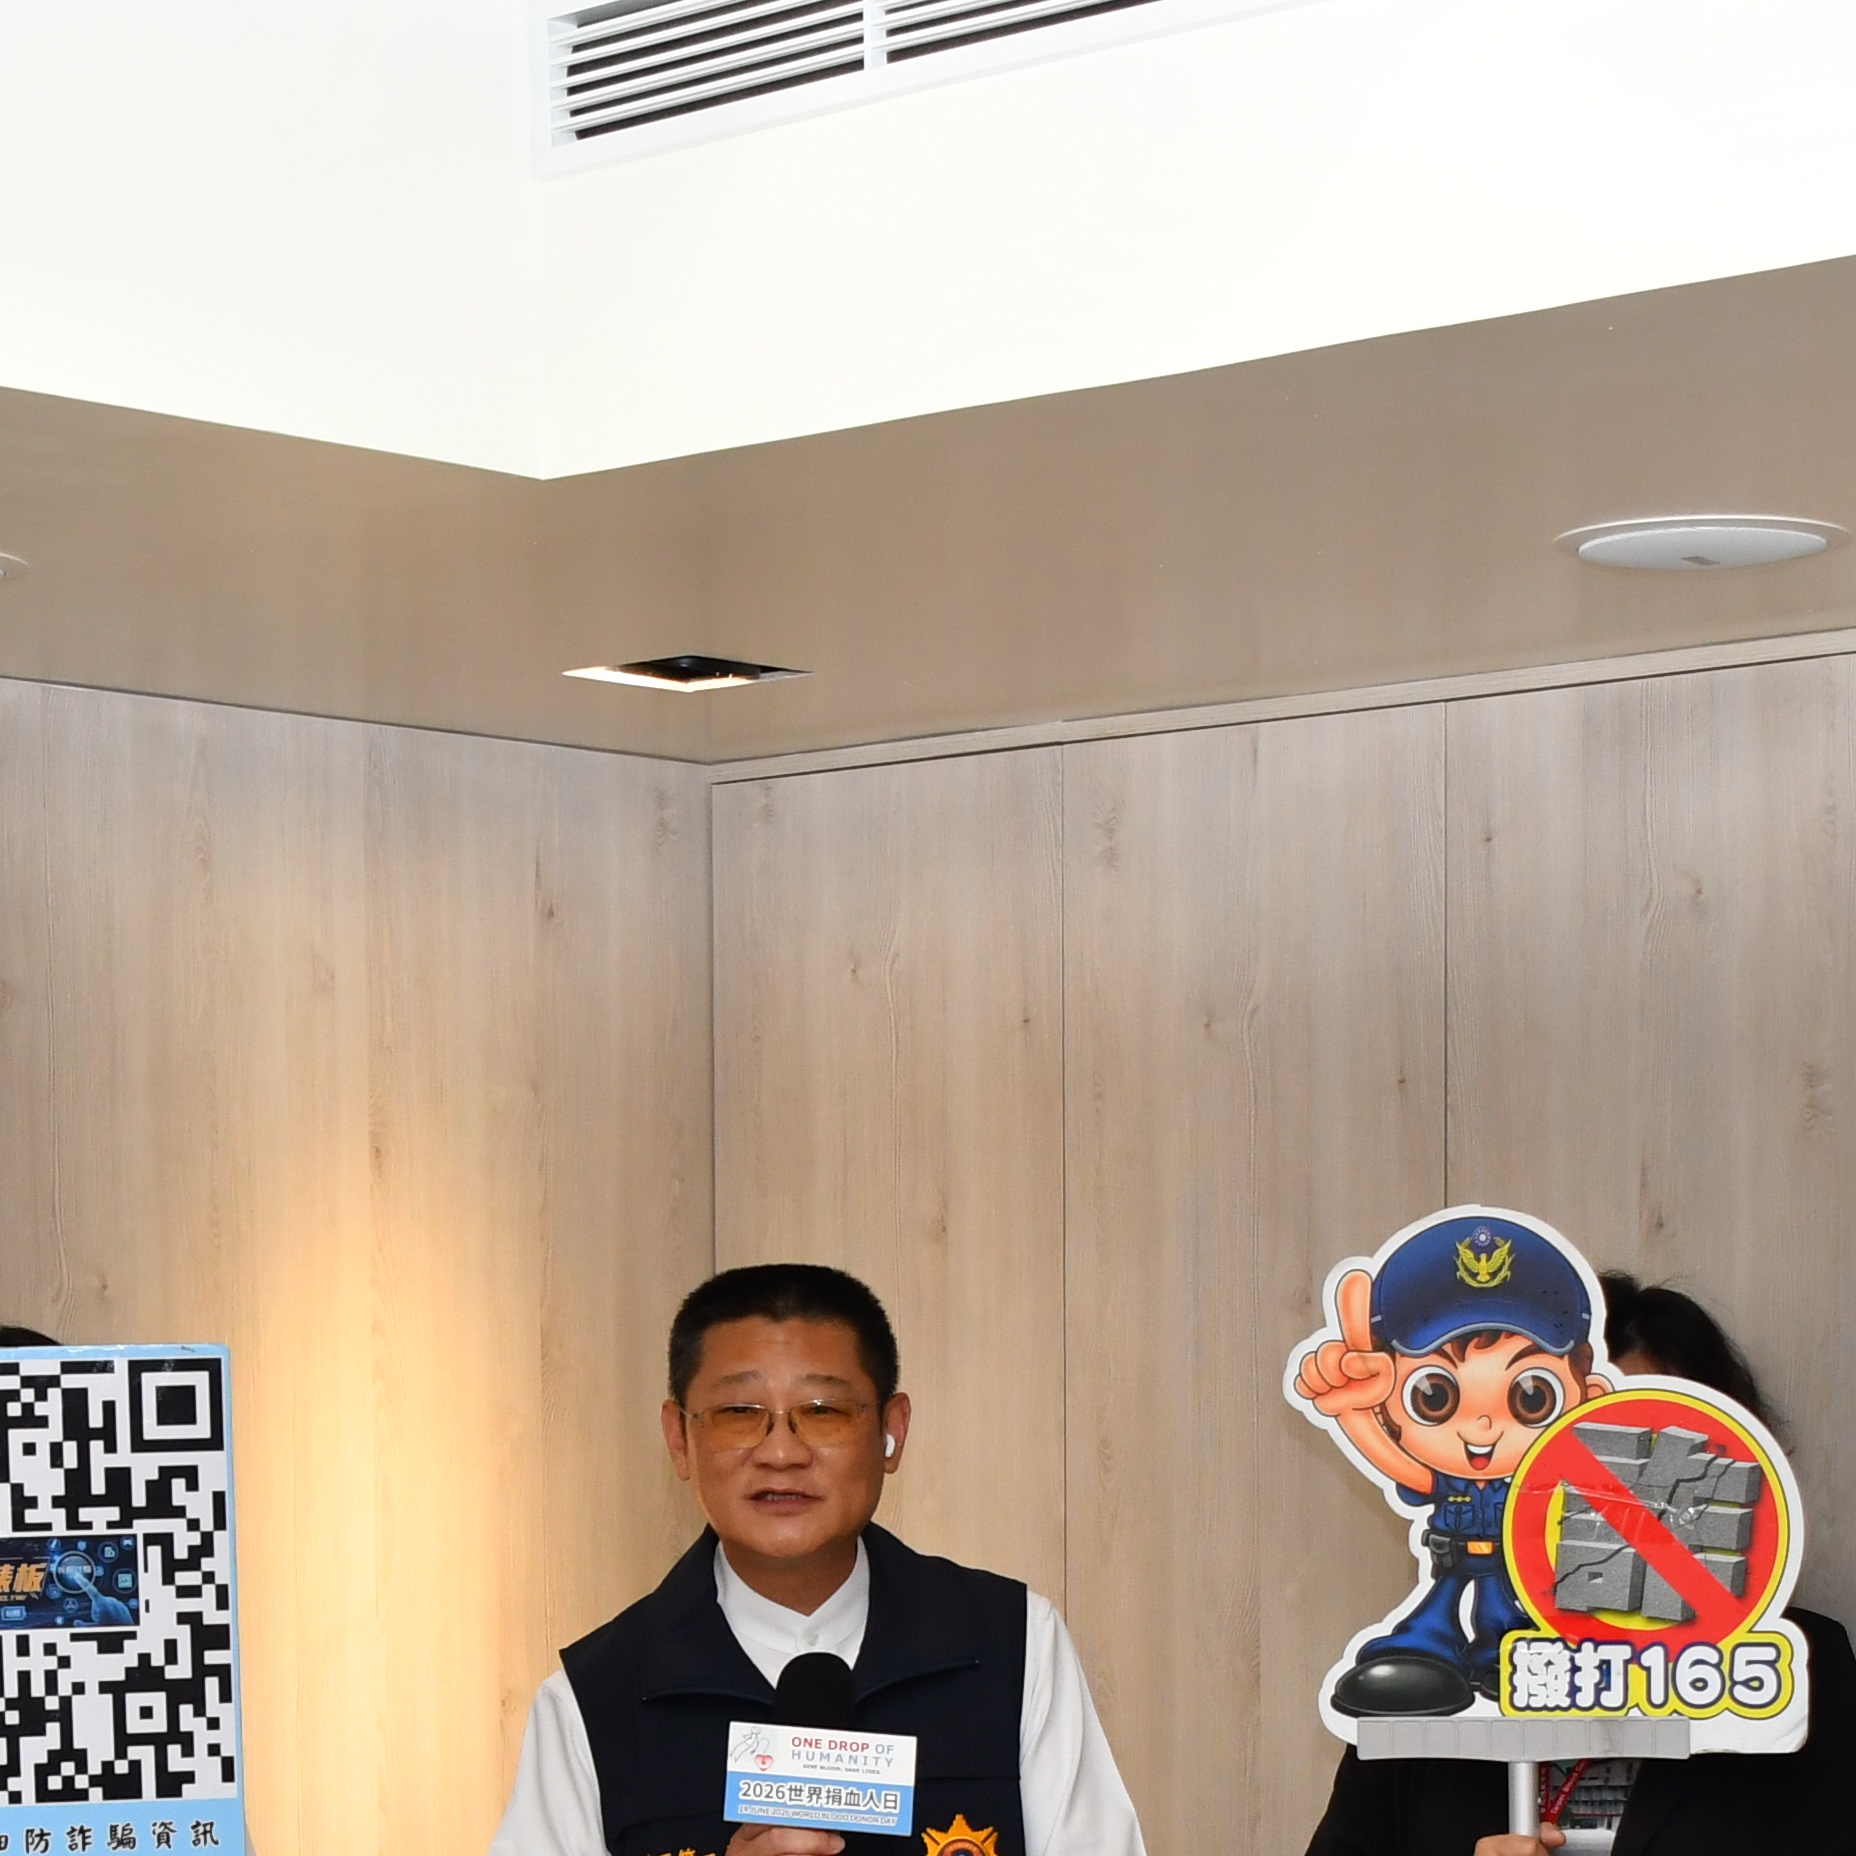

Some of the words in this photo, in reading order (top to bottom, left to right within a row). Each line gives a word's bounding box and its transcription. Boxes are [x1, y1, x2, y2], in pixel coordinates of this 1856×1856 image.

[1512, 1640, 1782, 1709] 撥打165
[791, 1736, 822, 1749] ONE
[828, 1740, 870, 1752] DROP
[875, 1744, 895, 1754] OF
[791, 1750, 894, 1768] HUMANITY
[741, 1781, 898, 1811] 2026世界捐血人日
[791, 1811, 819, 1819] WORLD
[821, 1813, 848, 1821] BLOOD
[850, 1815, 879, 1824] DONOR
[880, 1817, 896, 1825] DAY
